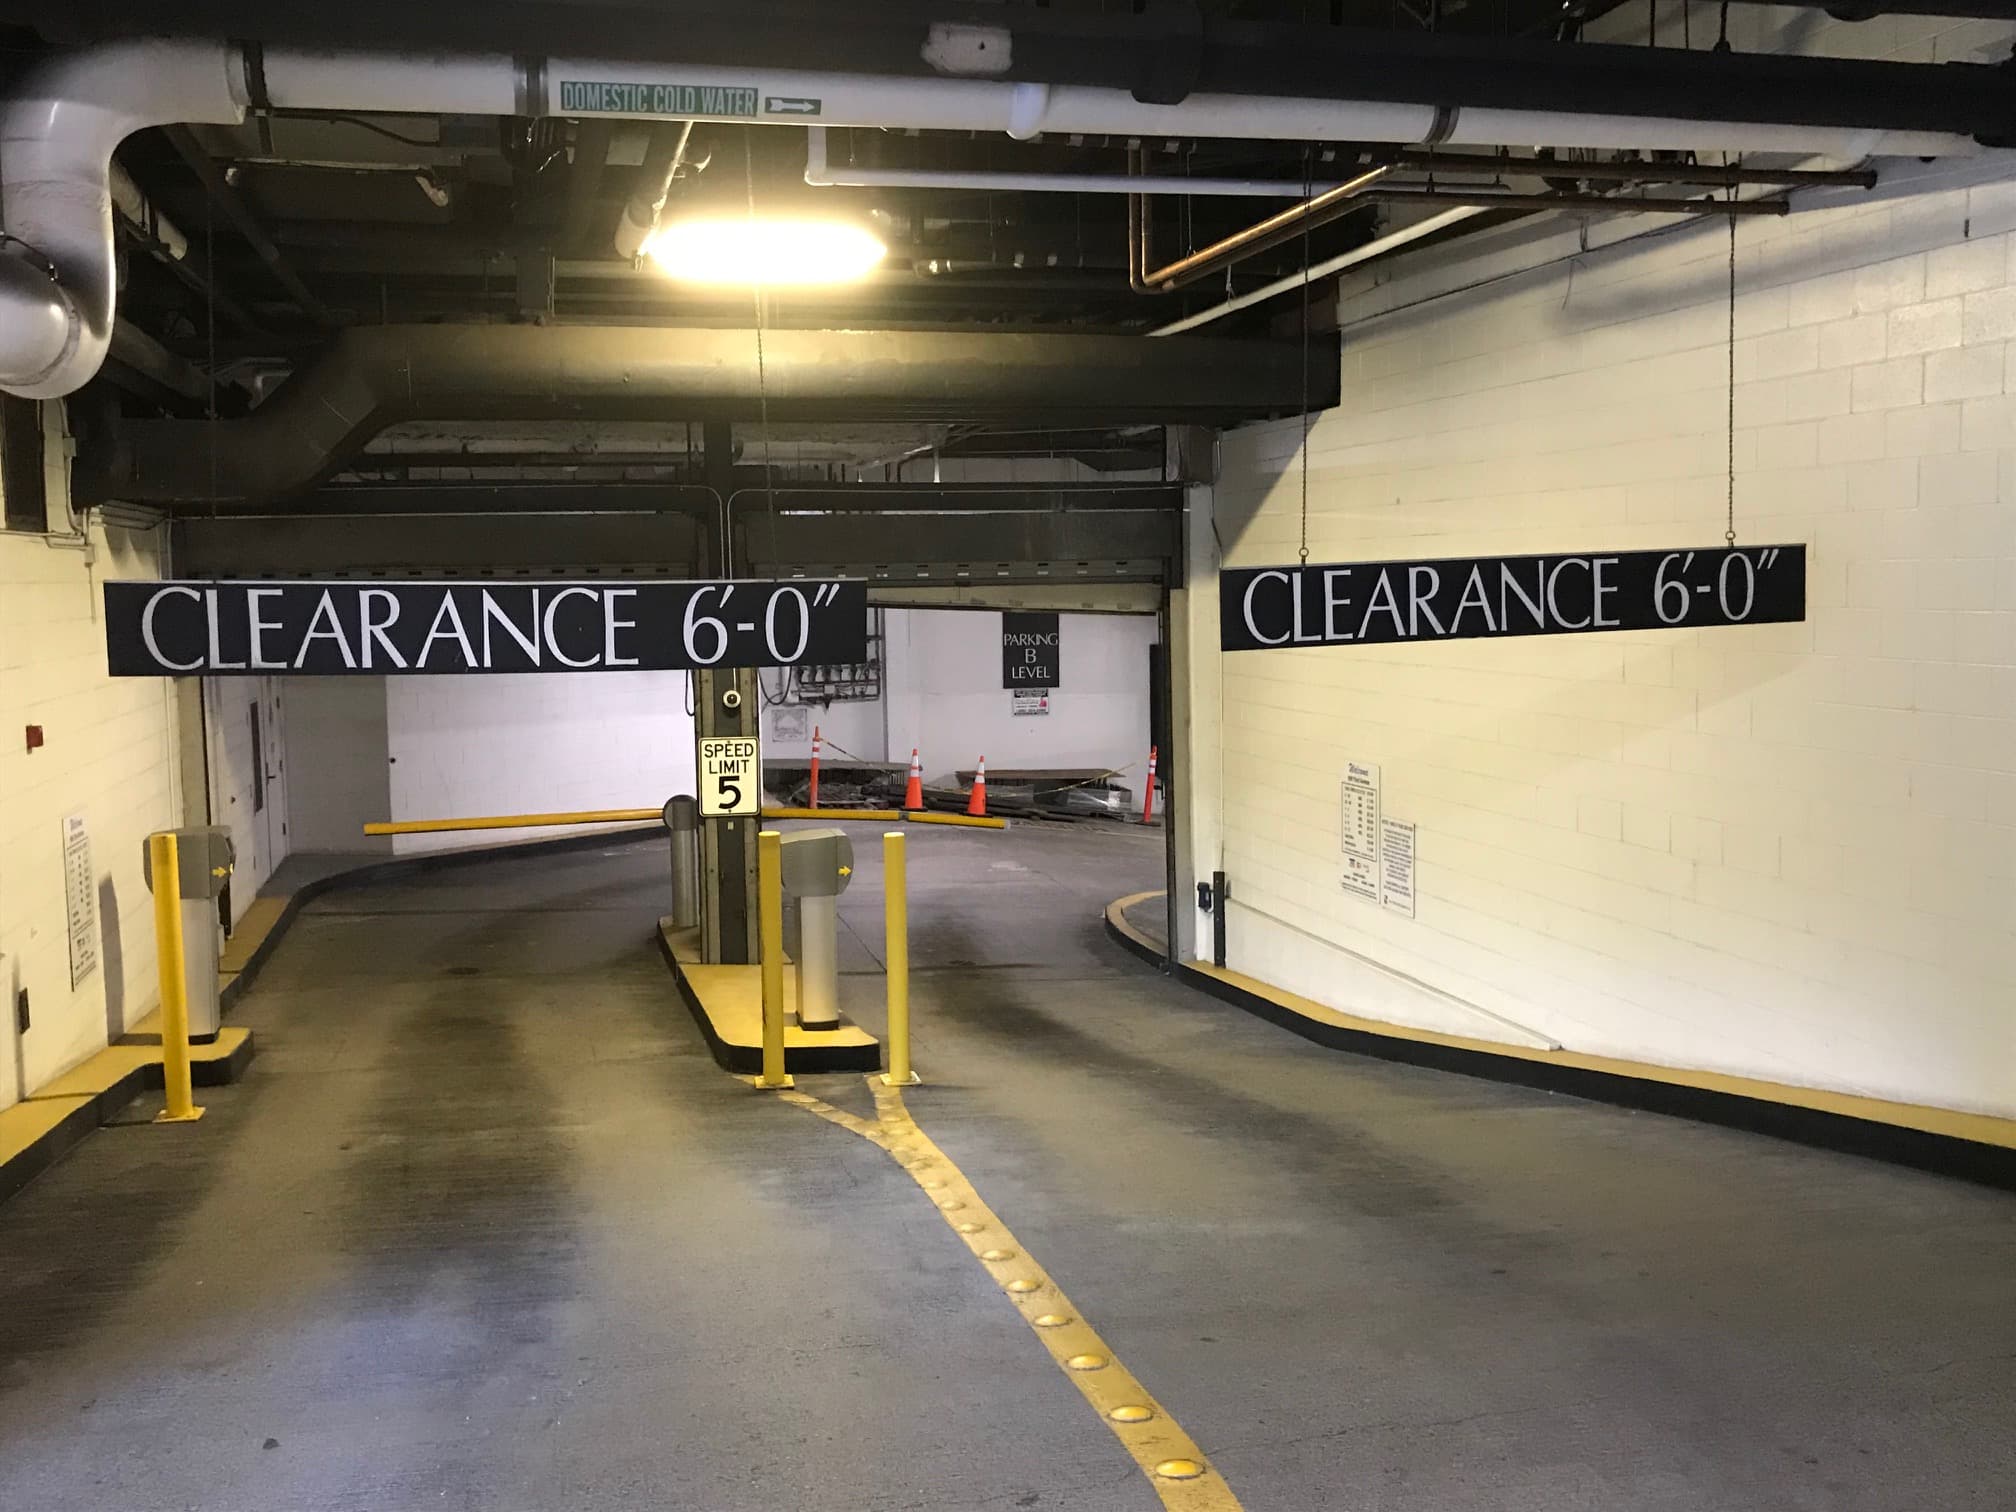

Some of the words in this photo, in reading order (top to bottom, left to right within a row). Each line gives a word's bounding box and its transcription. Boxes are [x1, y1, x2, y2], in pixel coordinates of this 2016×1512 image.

[563, 83, 648, 112] DOMESTIC
[653, 85, 696, 114] COLD
[701, 87, 755, 116] WATER
[1243, 557, 1621, 645] CLEARANCE
[1653, 548, 1779, 624] 6'-0"
[141, 586, 640, 671] CLEARANCE
[682, 583, 841, 665] 6'-0"
[1004, 632, 1058, 646] PARKING
[1025, 648, 1037, 664] B
[1012, 666, 1051, 679] LEVEL
[704, 743, 754, 758] SPEED
[709, 759, 750, 775] LIMIT
[718, 775, 742, 810] 5
